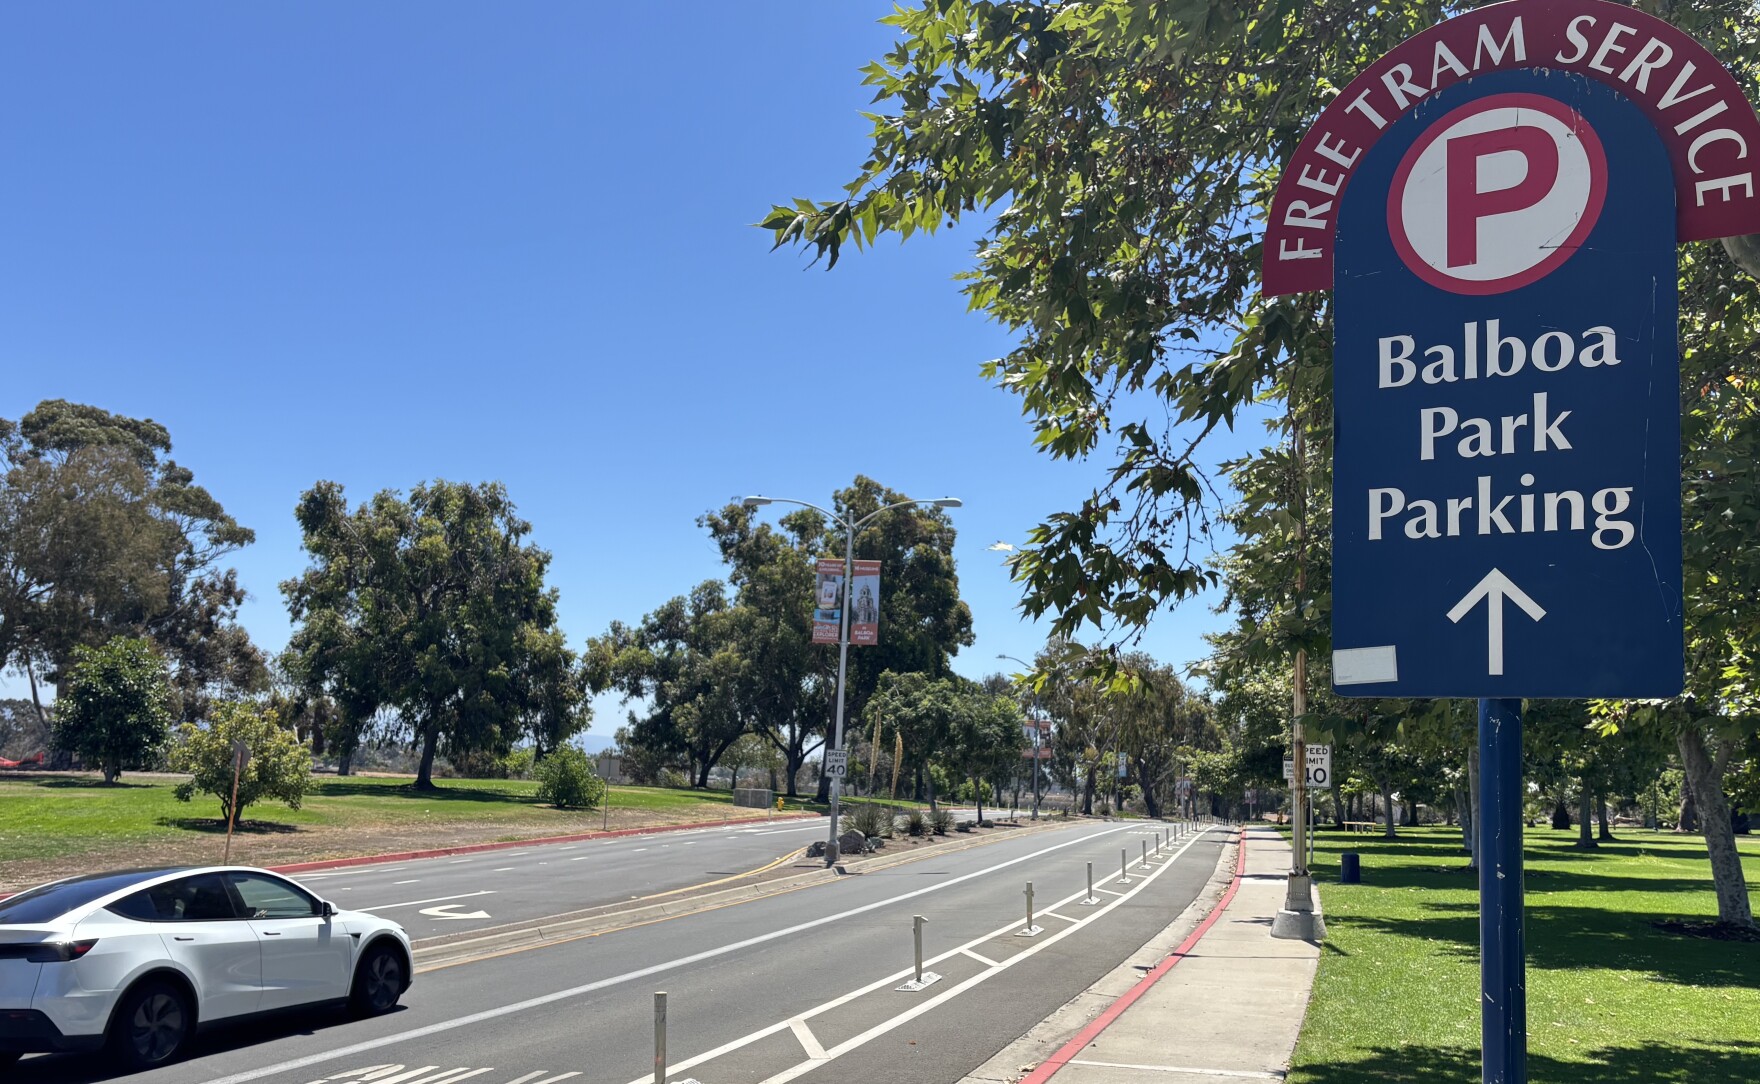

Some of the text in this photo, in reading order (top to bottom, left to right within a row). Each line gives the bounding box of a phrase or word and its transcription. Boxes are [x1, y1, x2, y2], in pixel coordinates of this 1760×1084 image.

[1279, 15, 1754, 261] FREE TRAM SERVICE
[1447, 126, 1559, 268] P
[1379, 319, 1622, 388] Balboa
[1420, 392, 1573, 460] Park
[1368, 473, 1635, 550] Parking
[827, 765, 845, 775] 40
